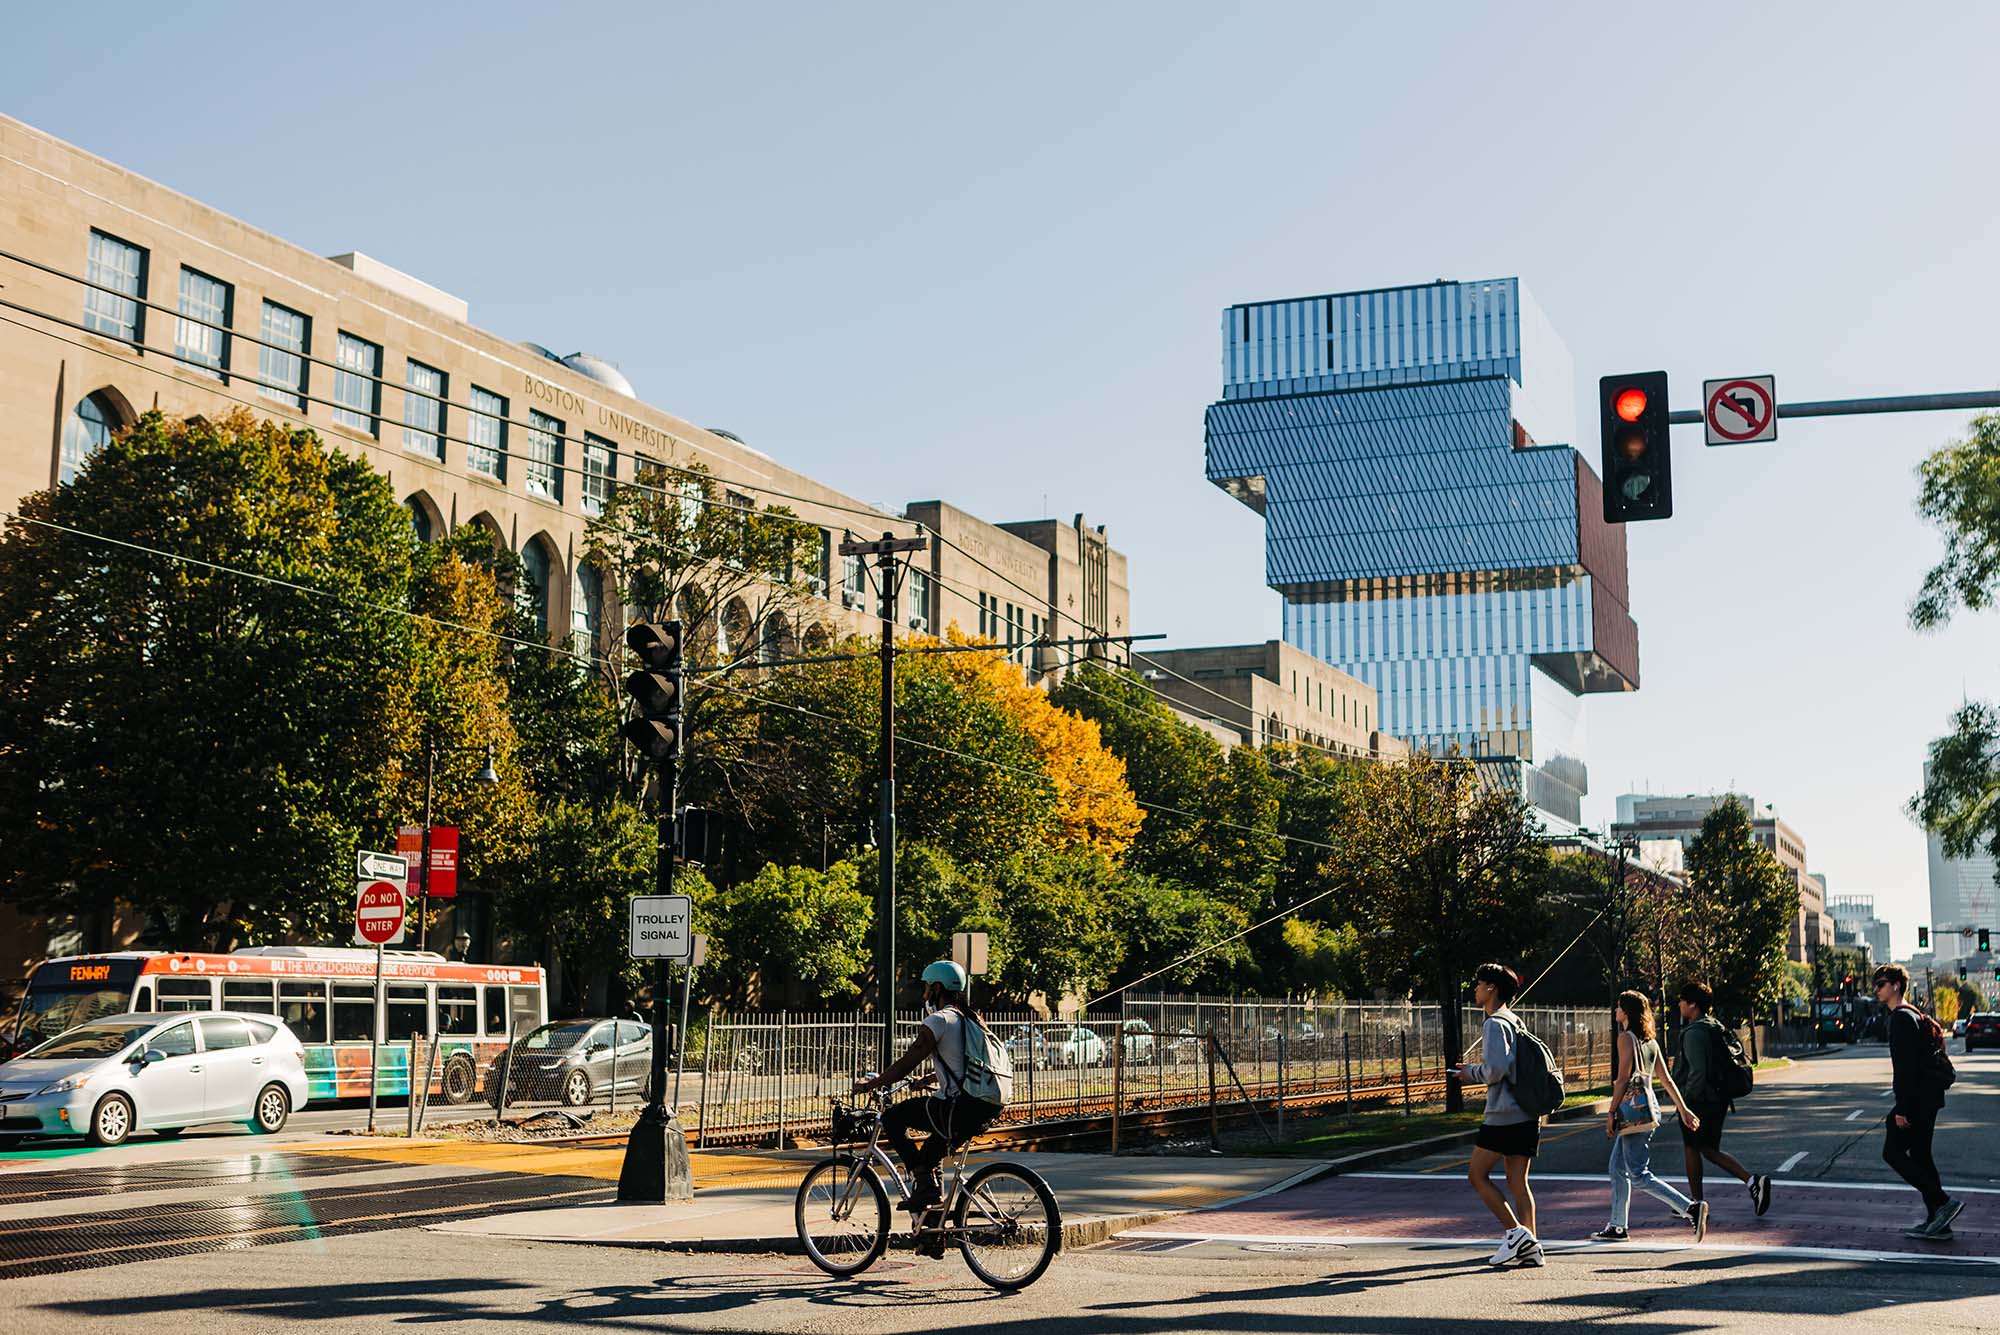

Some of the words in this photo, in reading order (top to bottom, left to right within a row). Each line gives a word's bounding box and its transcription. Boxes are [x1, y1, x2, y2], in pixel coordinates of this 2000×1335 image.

[525, 375, 584, 415] BOSTON
[598, 406, 677, 458] UNIVERSITY
[959, 533, 989, 560] BOSTON
[996, 550, 1038, 581] UNIVERSITY
[373, 861, 388, 872] ONE
[389, 864, 402, 875] WAY
[364, 894, 376, 904] DO
[380, 893, 397, 904] NOT
[366, 921, 393, 931] ENTER
[636, 915, 685, 924] TROLLEY
[640, 931, 680, 940] SIGNAL
[70, 965, 111, 981] FENWAY
[288, 960, 303, 972] THE
[304, 961, 335, 973] WORLD
[335, 962, 374, 974] CHANGES
[383, 964, 398, 975] ERE
[400, 965, 420, 976] EVERY
